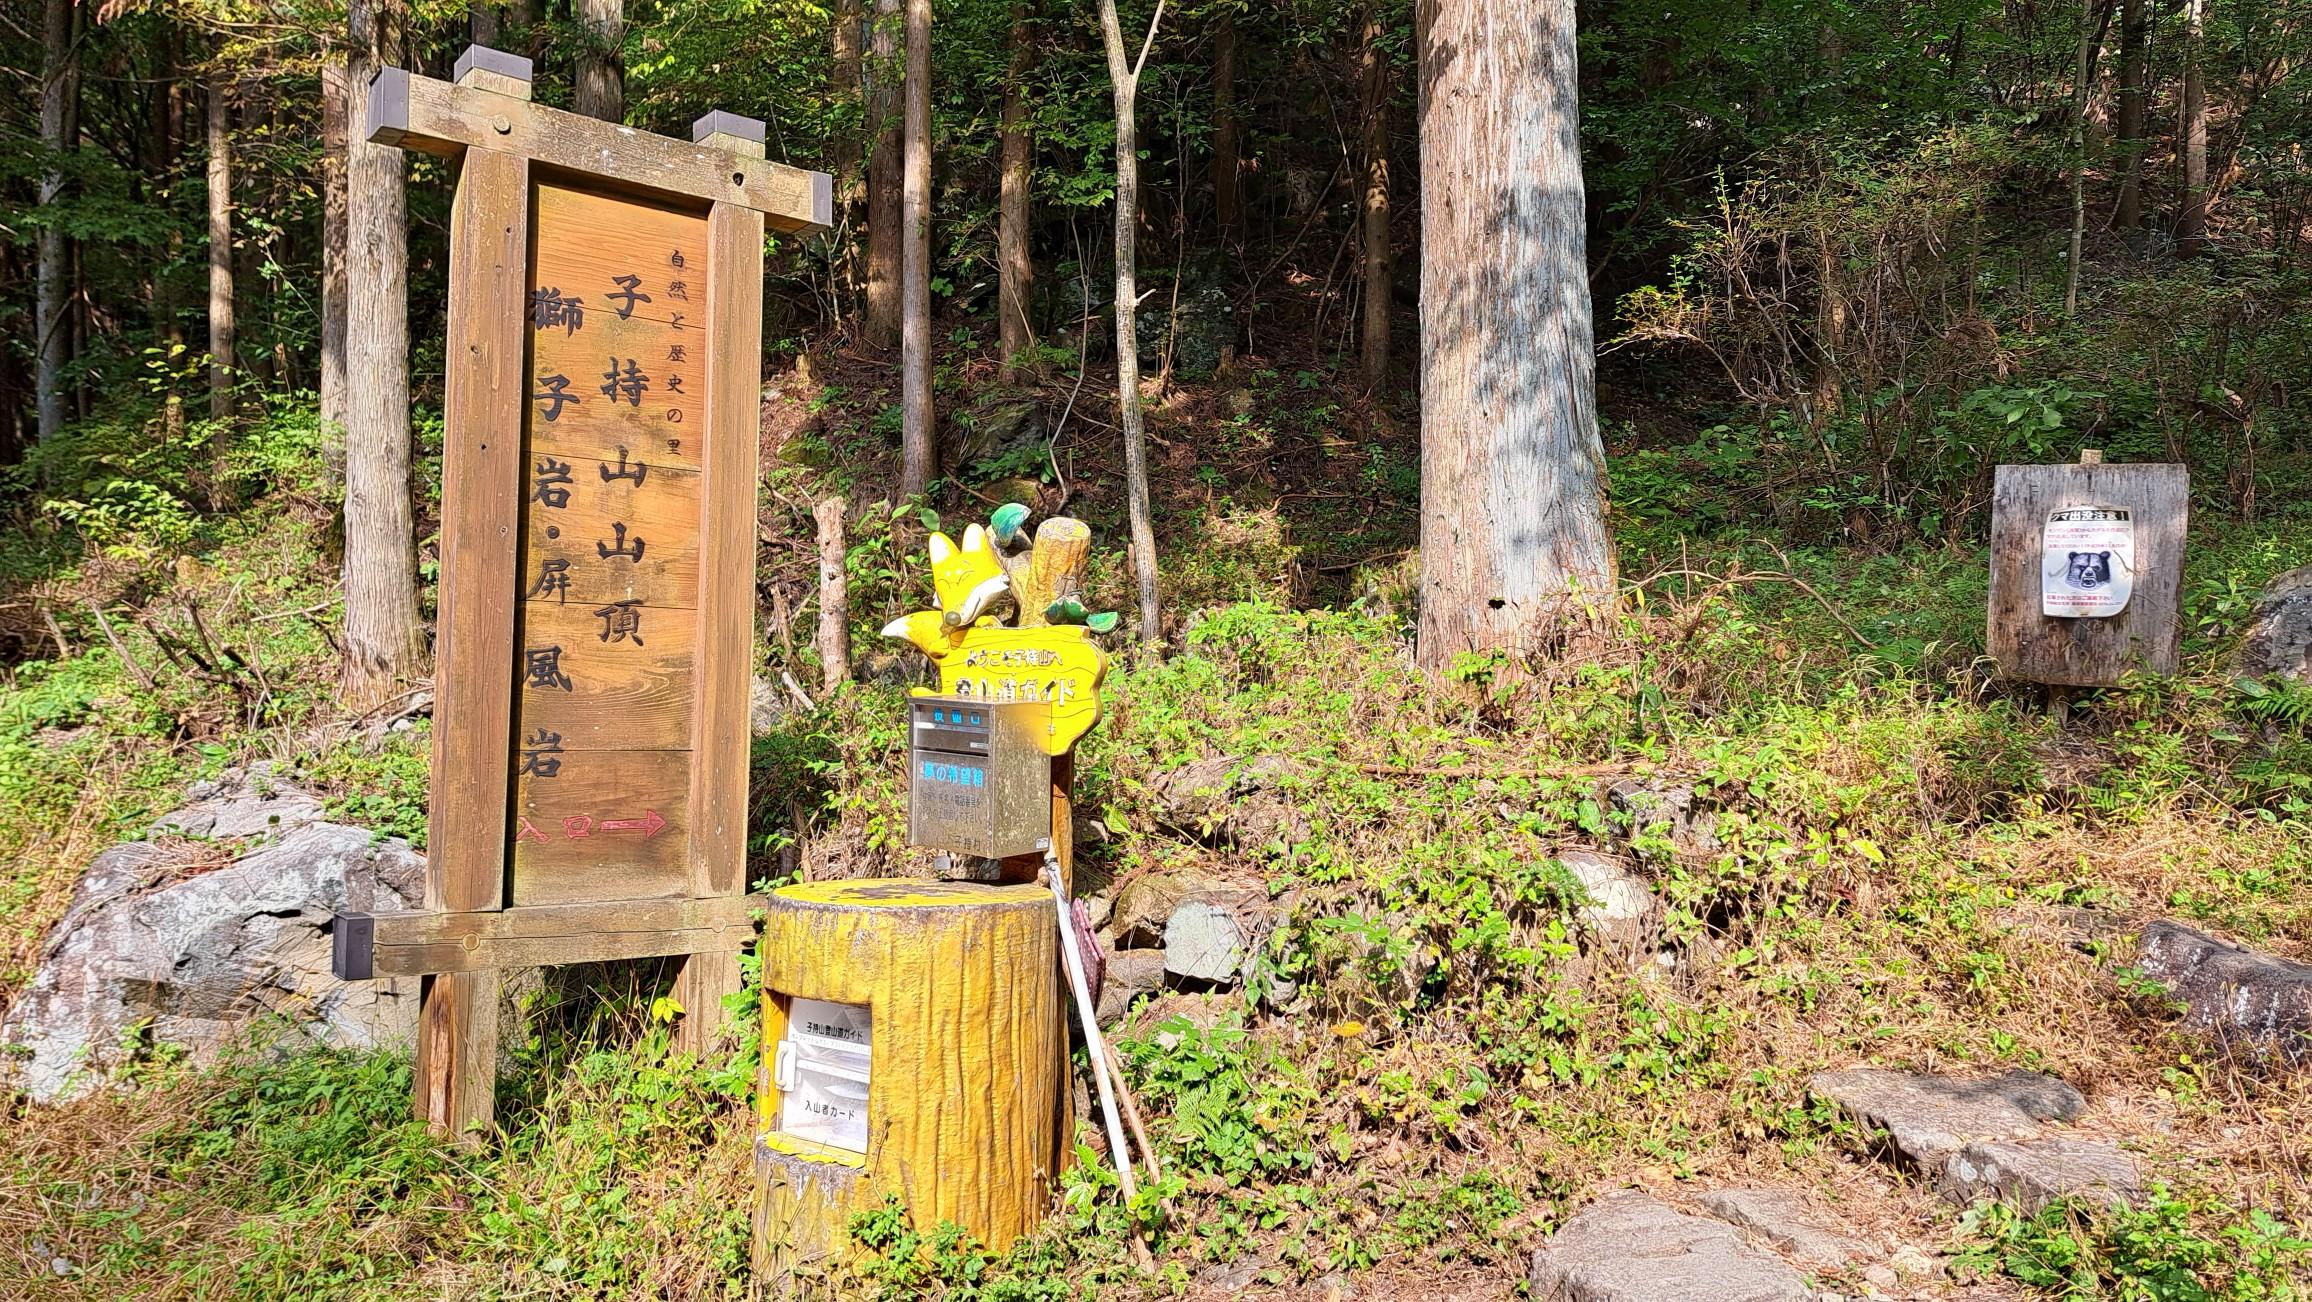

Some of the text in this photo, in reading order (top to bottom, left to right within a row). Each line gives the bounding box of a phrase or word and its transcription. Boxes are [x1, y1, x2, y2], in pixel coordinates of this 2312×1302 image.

[665, 249, 689, 456] 自然と歴史の里
[593, 273, 652, 647] 子持山山頂
[965, 648, 1064, 668] ようこそ子持山へ
[955, 677, 1076, 707] 登山道ガイド
[923, 761, 984, 788] 夢の希望箱
[515, 815, 592, 842] 入口
[806, 1021, 864, 1041] 子持山登山道ガイド
[804, 1100, 855, 1121] 入山者カード
